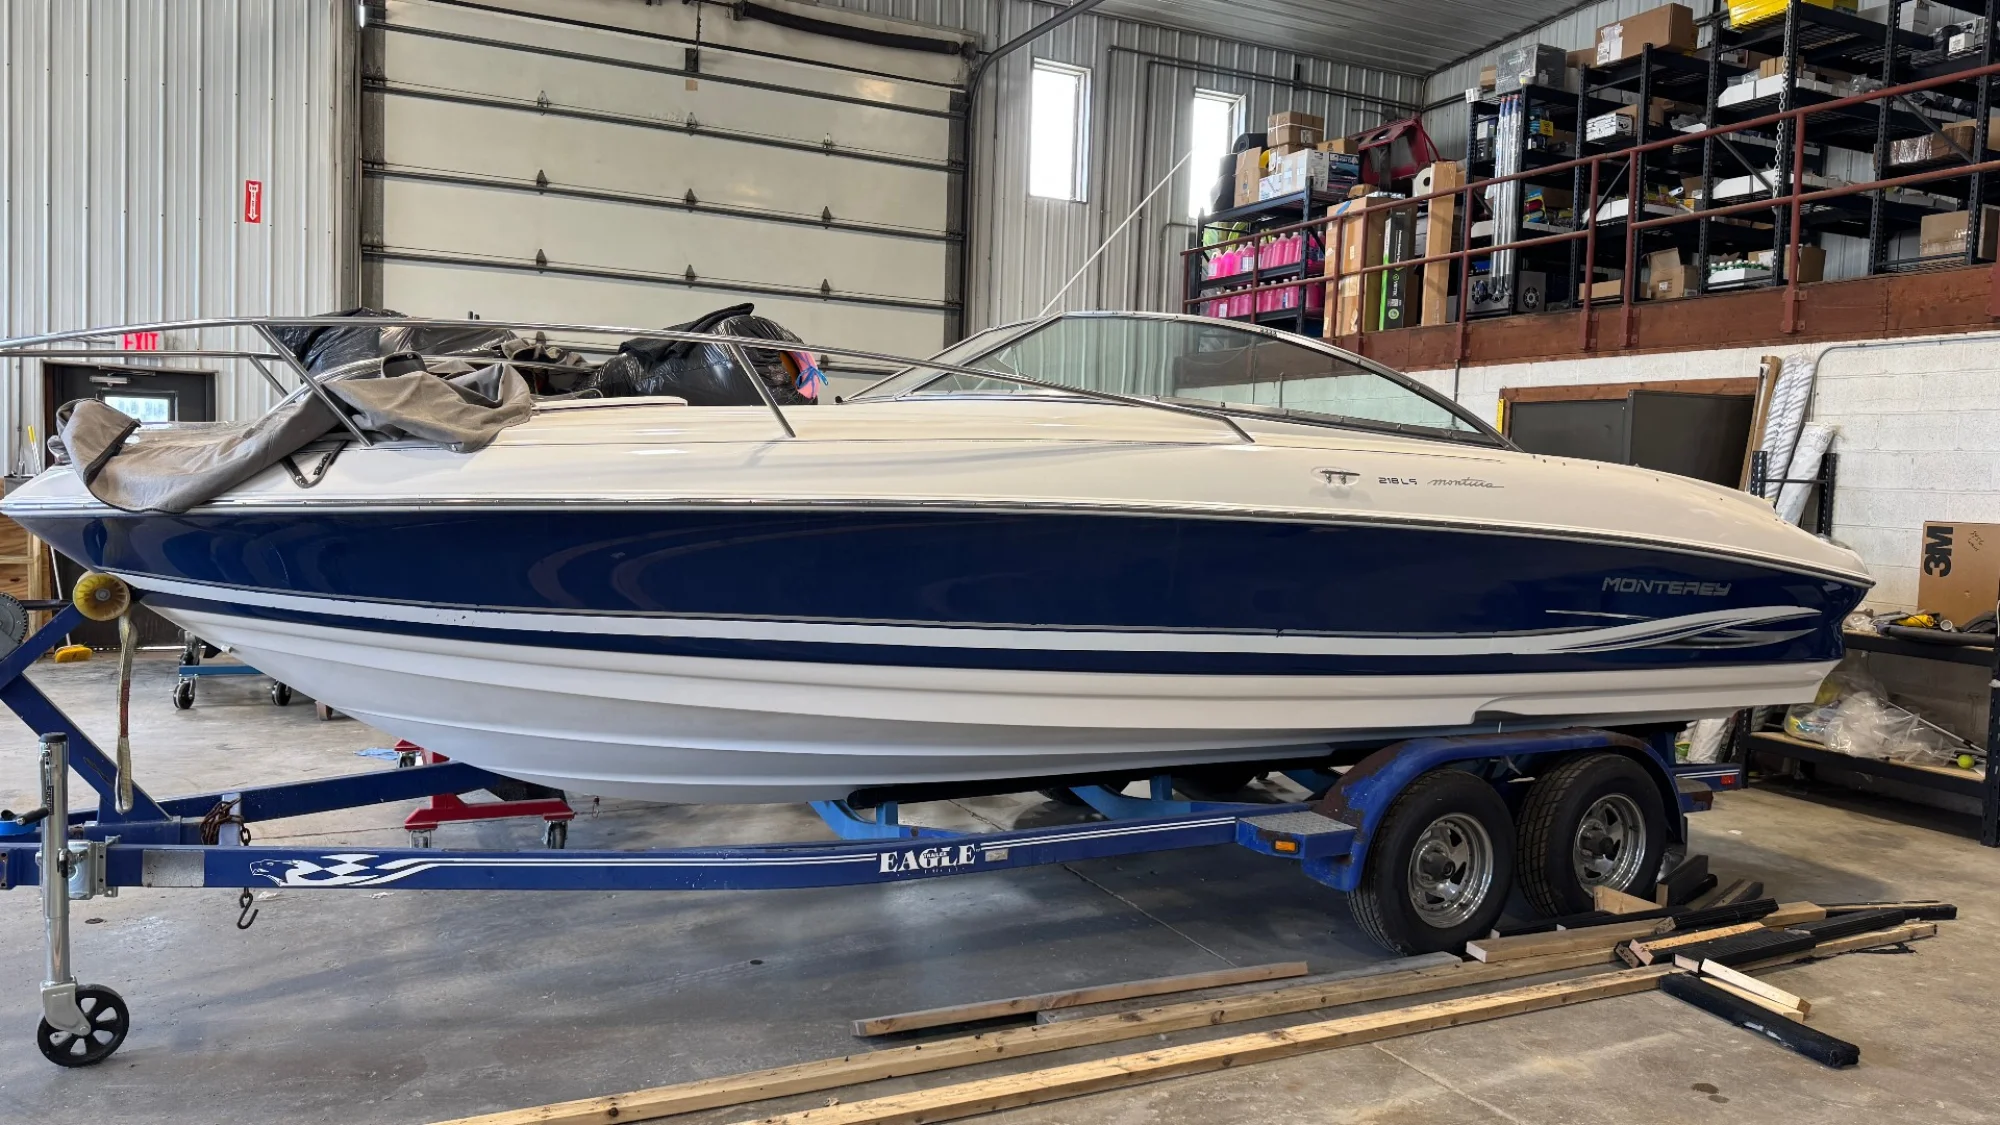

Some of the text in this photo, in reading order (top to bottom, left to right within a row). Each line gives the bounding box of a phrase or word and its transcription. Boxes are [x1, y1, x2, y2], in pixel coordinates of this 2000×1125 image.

[123, 332, 158, 351] EXIT
[1924, 526, 1953, 577] 3M
[1601, 576, 1732, 597] MONTEREY
[879, 844, 976, 873] EAGLE
